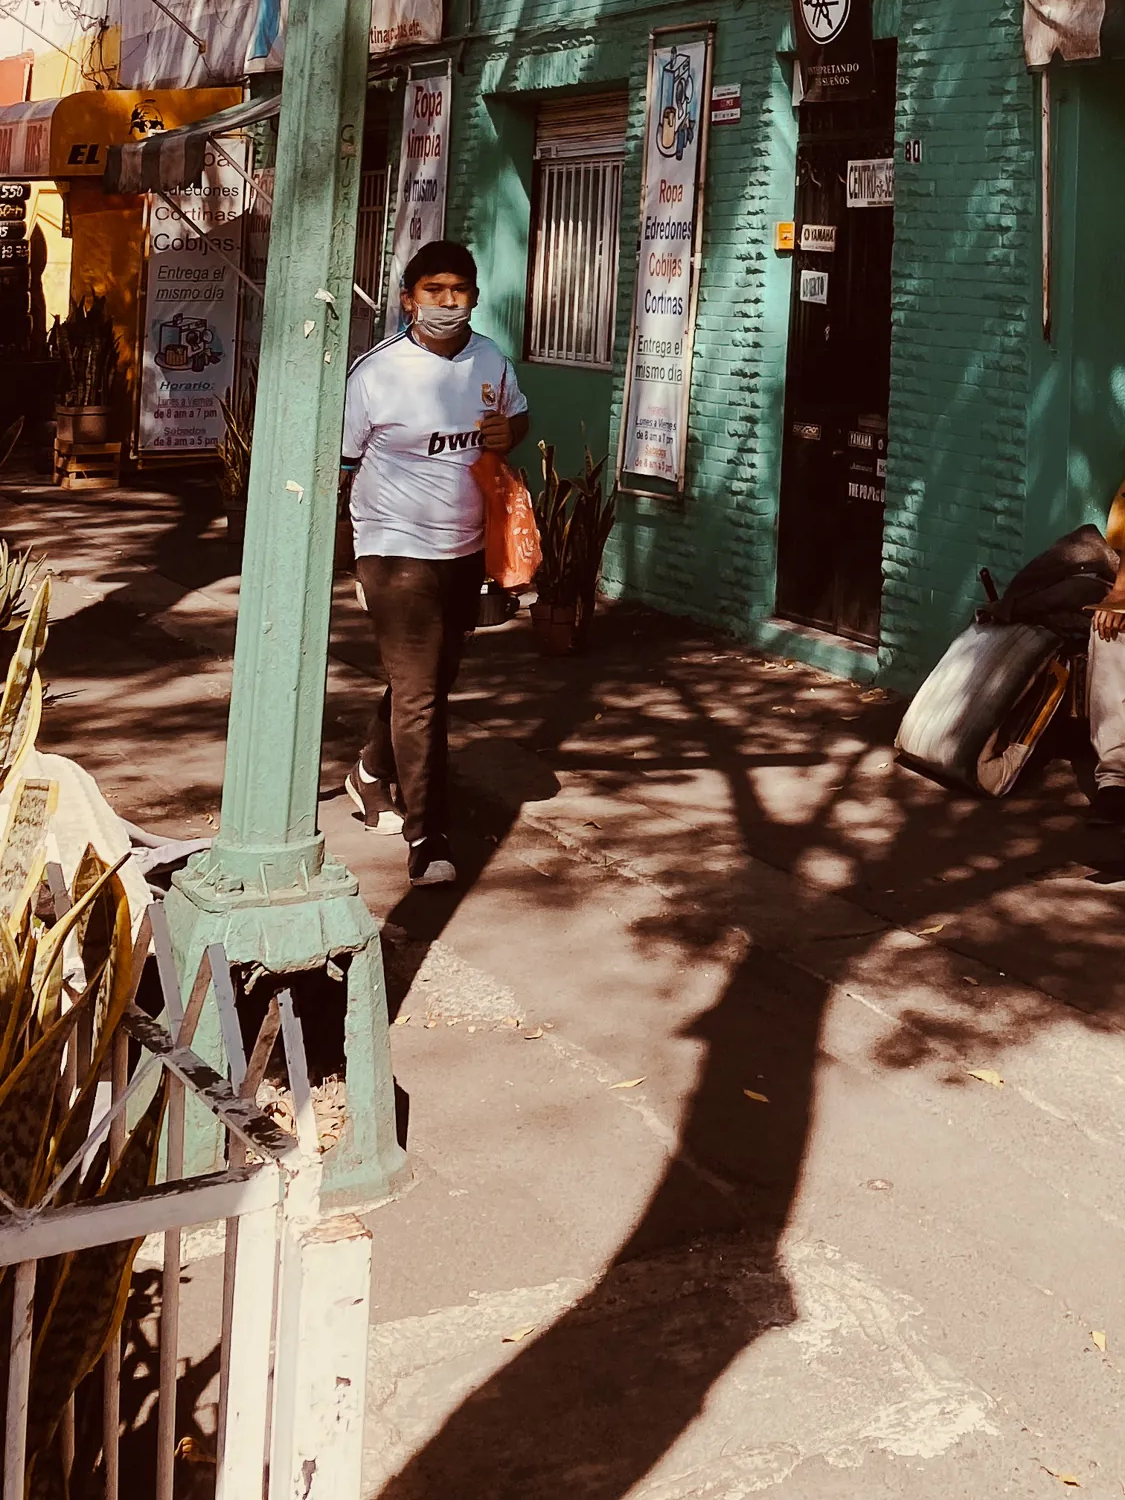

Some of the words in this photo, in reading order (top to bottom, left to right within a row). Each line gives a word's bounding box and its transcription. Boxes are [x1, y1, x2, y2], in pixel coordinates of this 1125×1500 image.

[413, 86, 442, 125] Ropa
[67, 144, 100, 164] EL
[407, 127, 440, 164] limpia
[905, 140, 921, 164] 80
[1, 185, 23, 198] 550
[404, 173, 411, 202] el
[412, 173, 437, 202] mismo
[659, 179, 683, 209] Ropa
[155, 206, 237, 222] Cortinas
[645, 216, 692, 240] Edredones
[811, 229, 834, 242] YAMAHA
[158, 265, 208, 282] Entrega
[213, 266, 225, 280] el
[649, 252, 682, 283] Cobijas
[156, 287, 200, 299] mismo
[644, 289, 683, 315] Cortinas
[638, 335, 671, 358] Entrega
[674, 338, 683, 355] el
[635, 361, 665, 380] mismo
[154, 409, 164, 418] de
[167, 408, 171, 418] 8
[174, 410, 187, 418] am
[197, 408, 201, 418] 7
[204, 409, 217, 419] pm
[154, 437, 164, 446] de
[174, 438, 187, 446] am
[205, 437, 218, 447] pm
